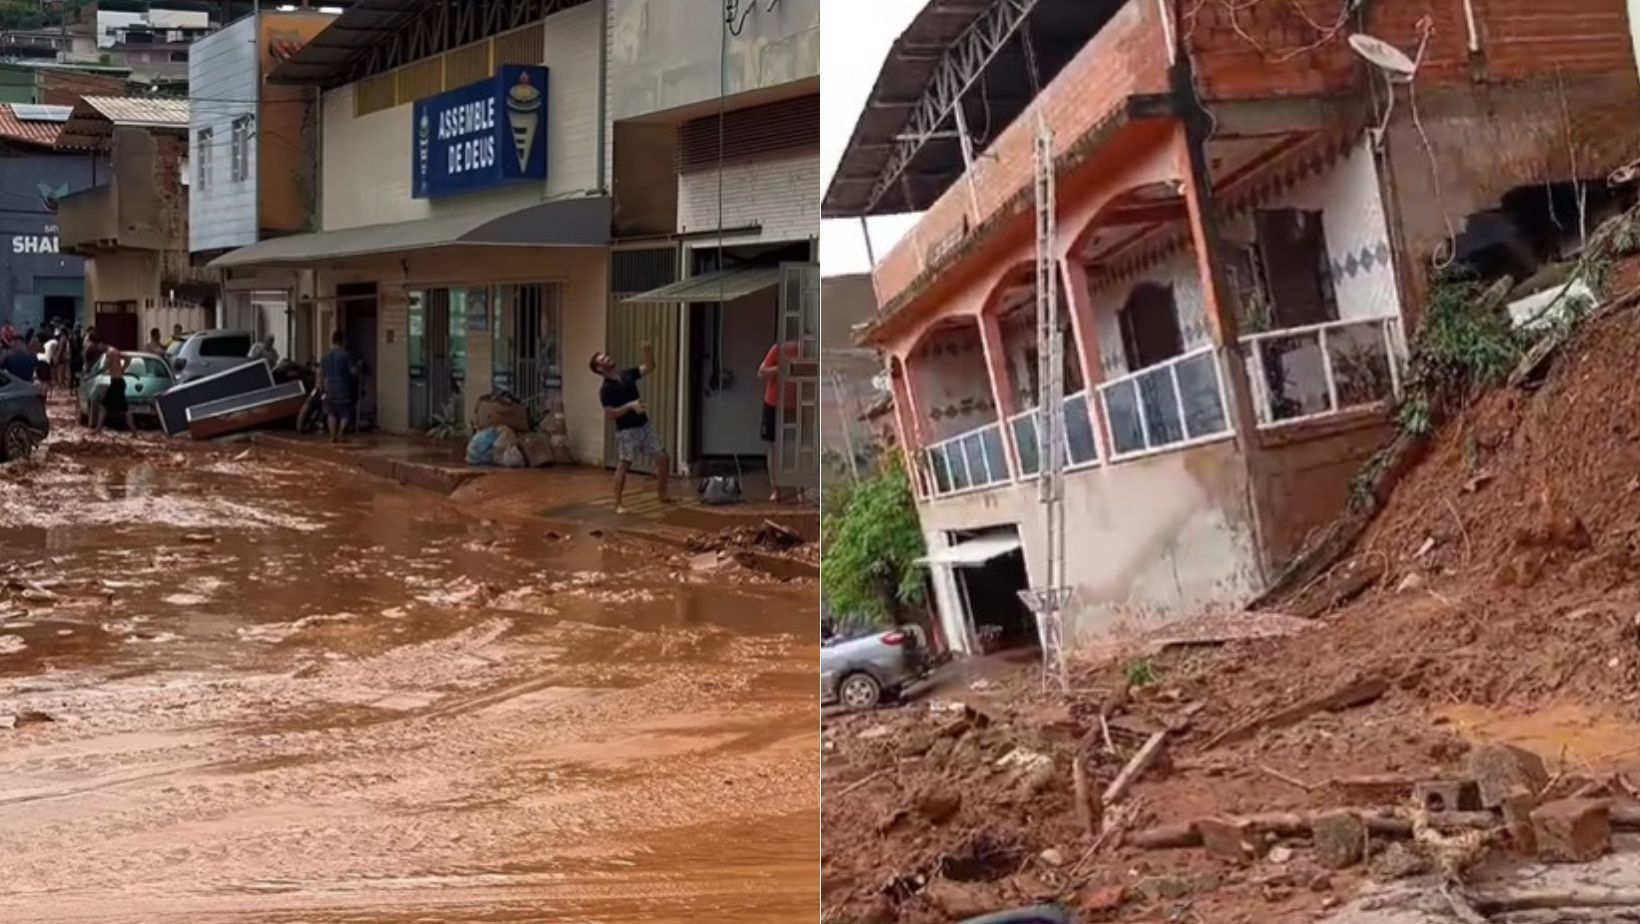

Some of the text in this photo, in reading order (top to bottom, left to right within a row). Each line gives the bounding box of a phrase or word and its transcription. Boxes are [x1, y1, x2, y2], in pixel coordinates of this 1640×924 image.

[438, 97, 495, 140] ASSEMBLE
[448, 136, 495, 174] DE DEUS
